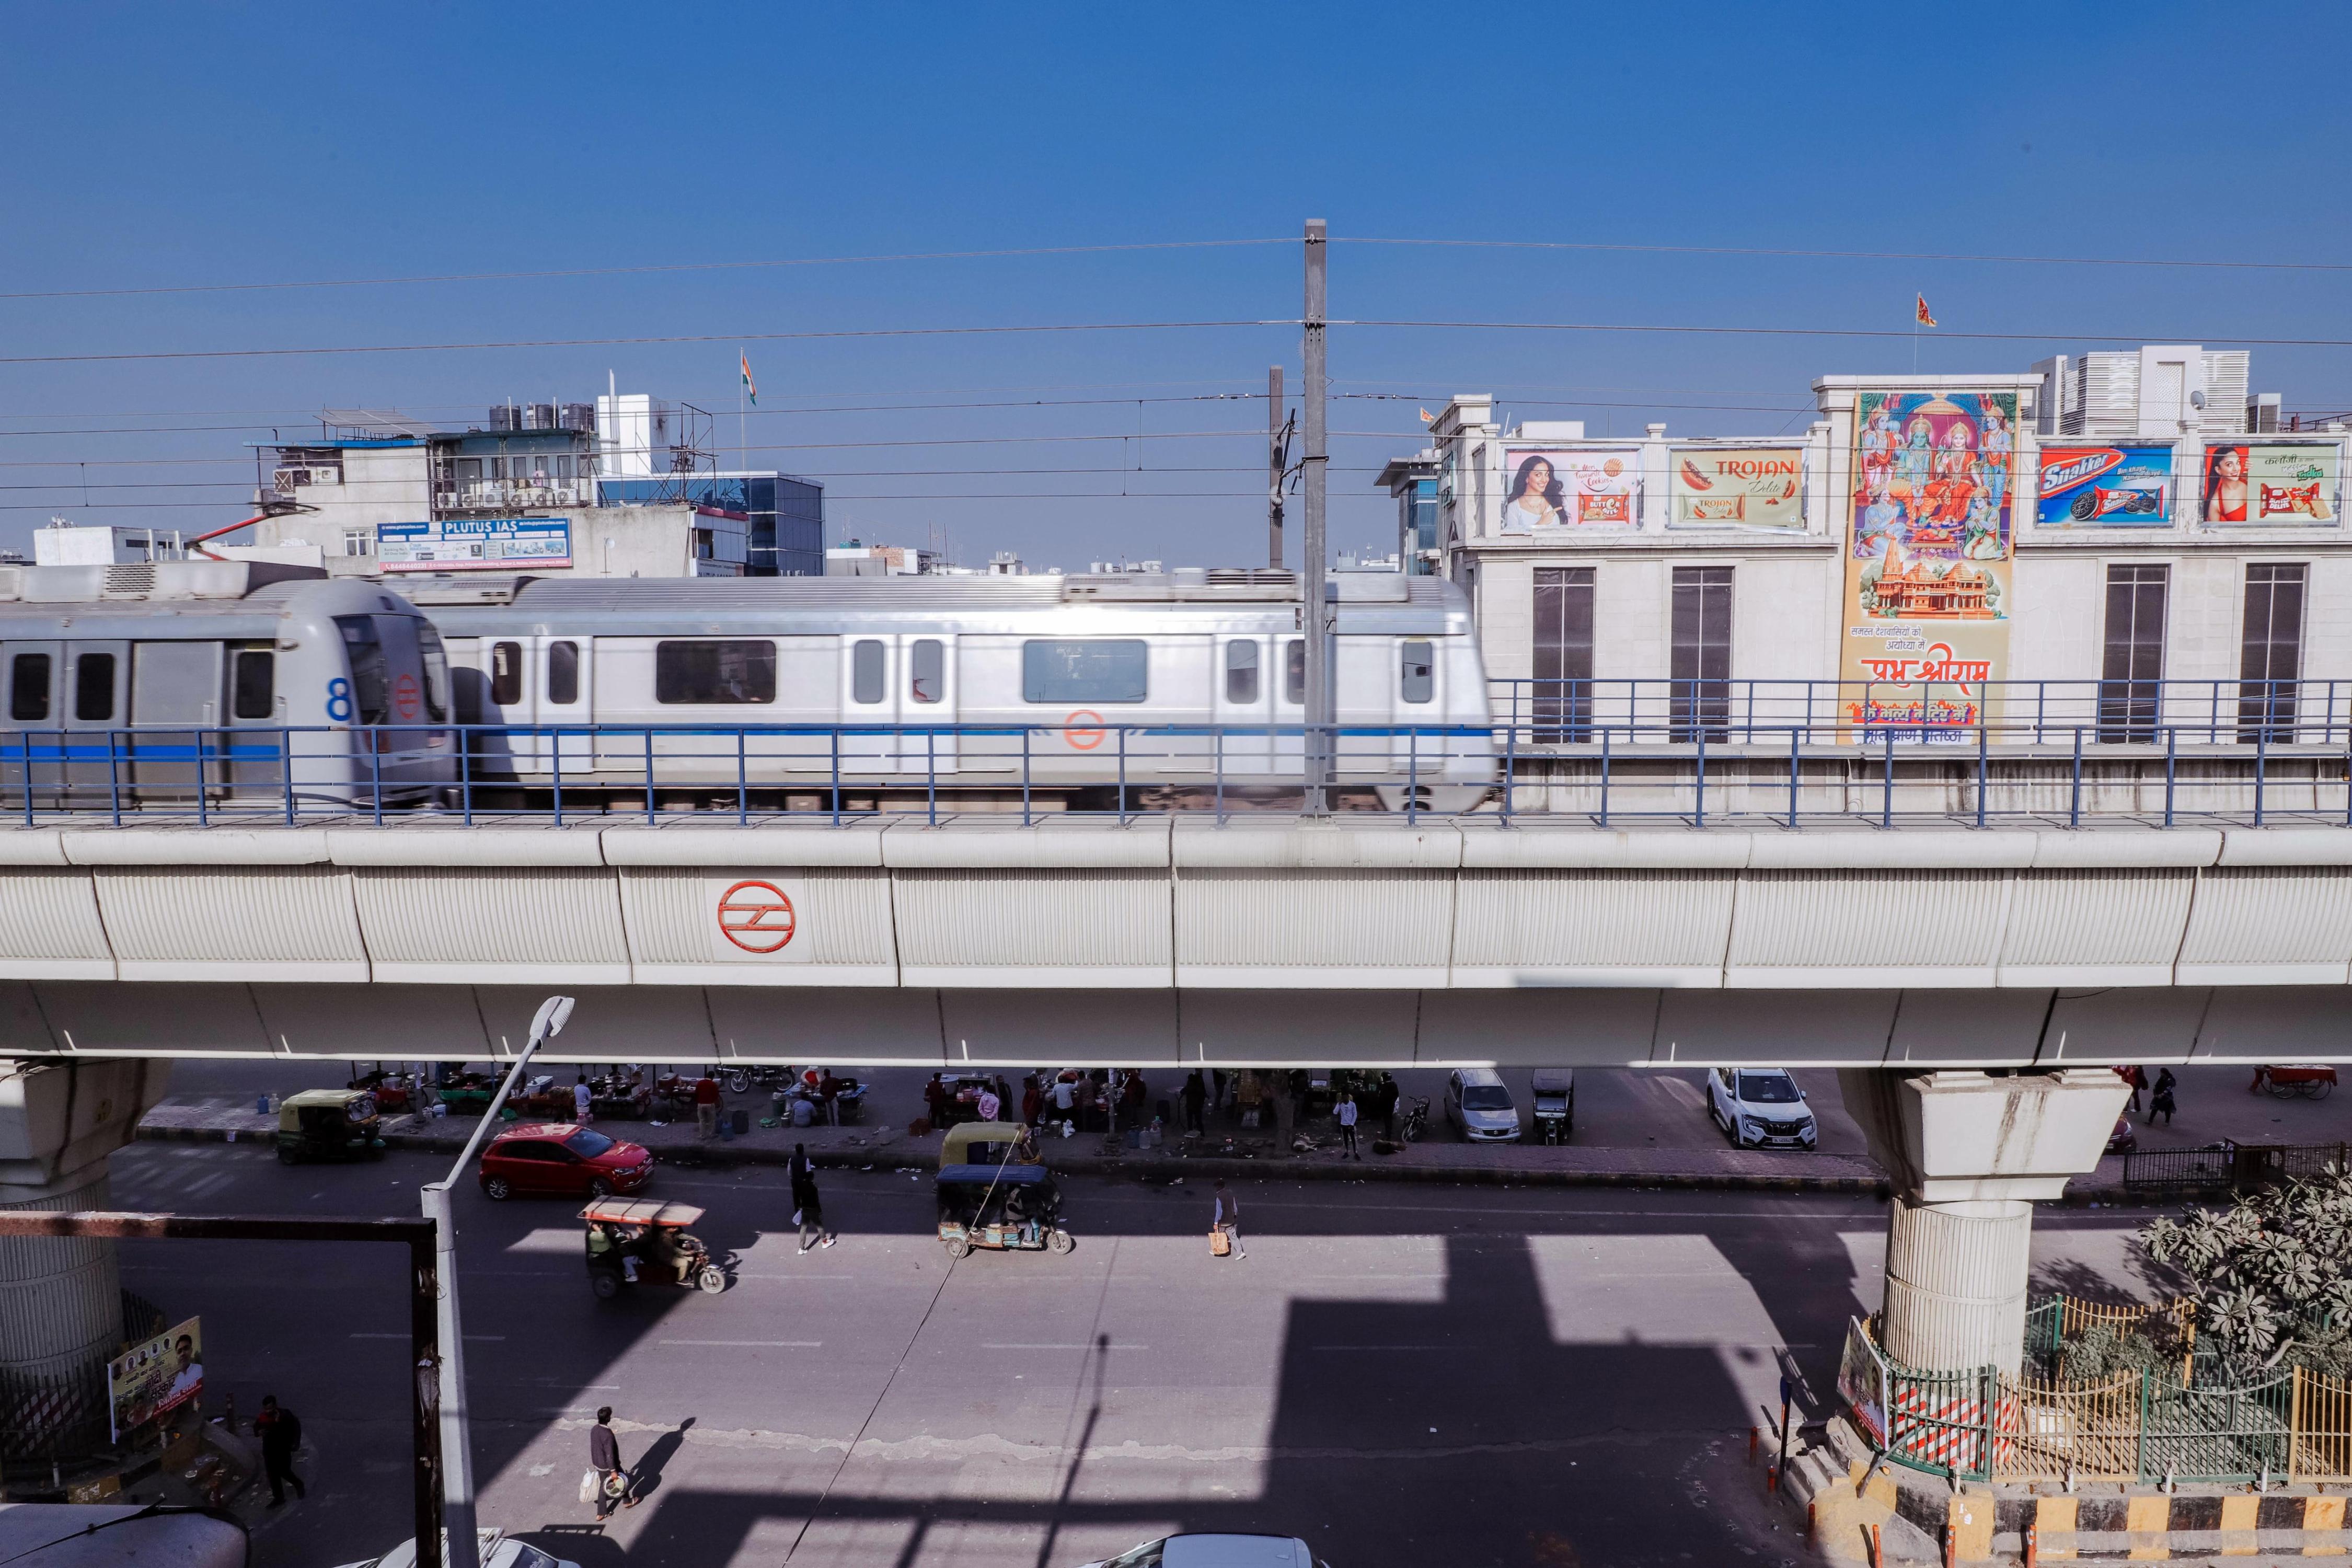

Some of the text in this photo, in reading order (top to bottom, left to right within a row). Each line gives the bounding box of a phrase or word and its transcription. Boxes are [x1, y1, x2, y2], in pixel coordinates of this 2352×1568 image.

[1715, 460, 1794, 480] TROJAN
[2043, 454, 2109, 490] Snakker
[1588, 477, 1610, 487] Cookies
[1749, 480, 1781, 493] Delite
[1700, 500, 1732, 508] TROJAN
[445, 521, 492, 533] PLUTUS
[497, 521, 517, 532] IAS
[1875, 626, 1910, 636] देशवासियों
[1911, 626, 1921, 636] को
[1886, 638, 1926, 650] अयोध्या में
[1861, 660, 1919, 688] प्रभु
[326, 677, 352, 722] 8
